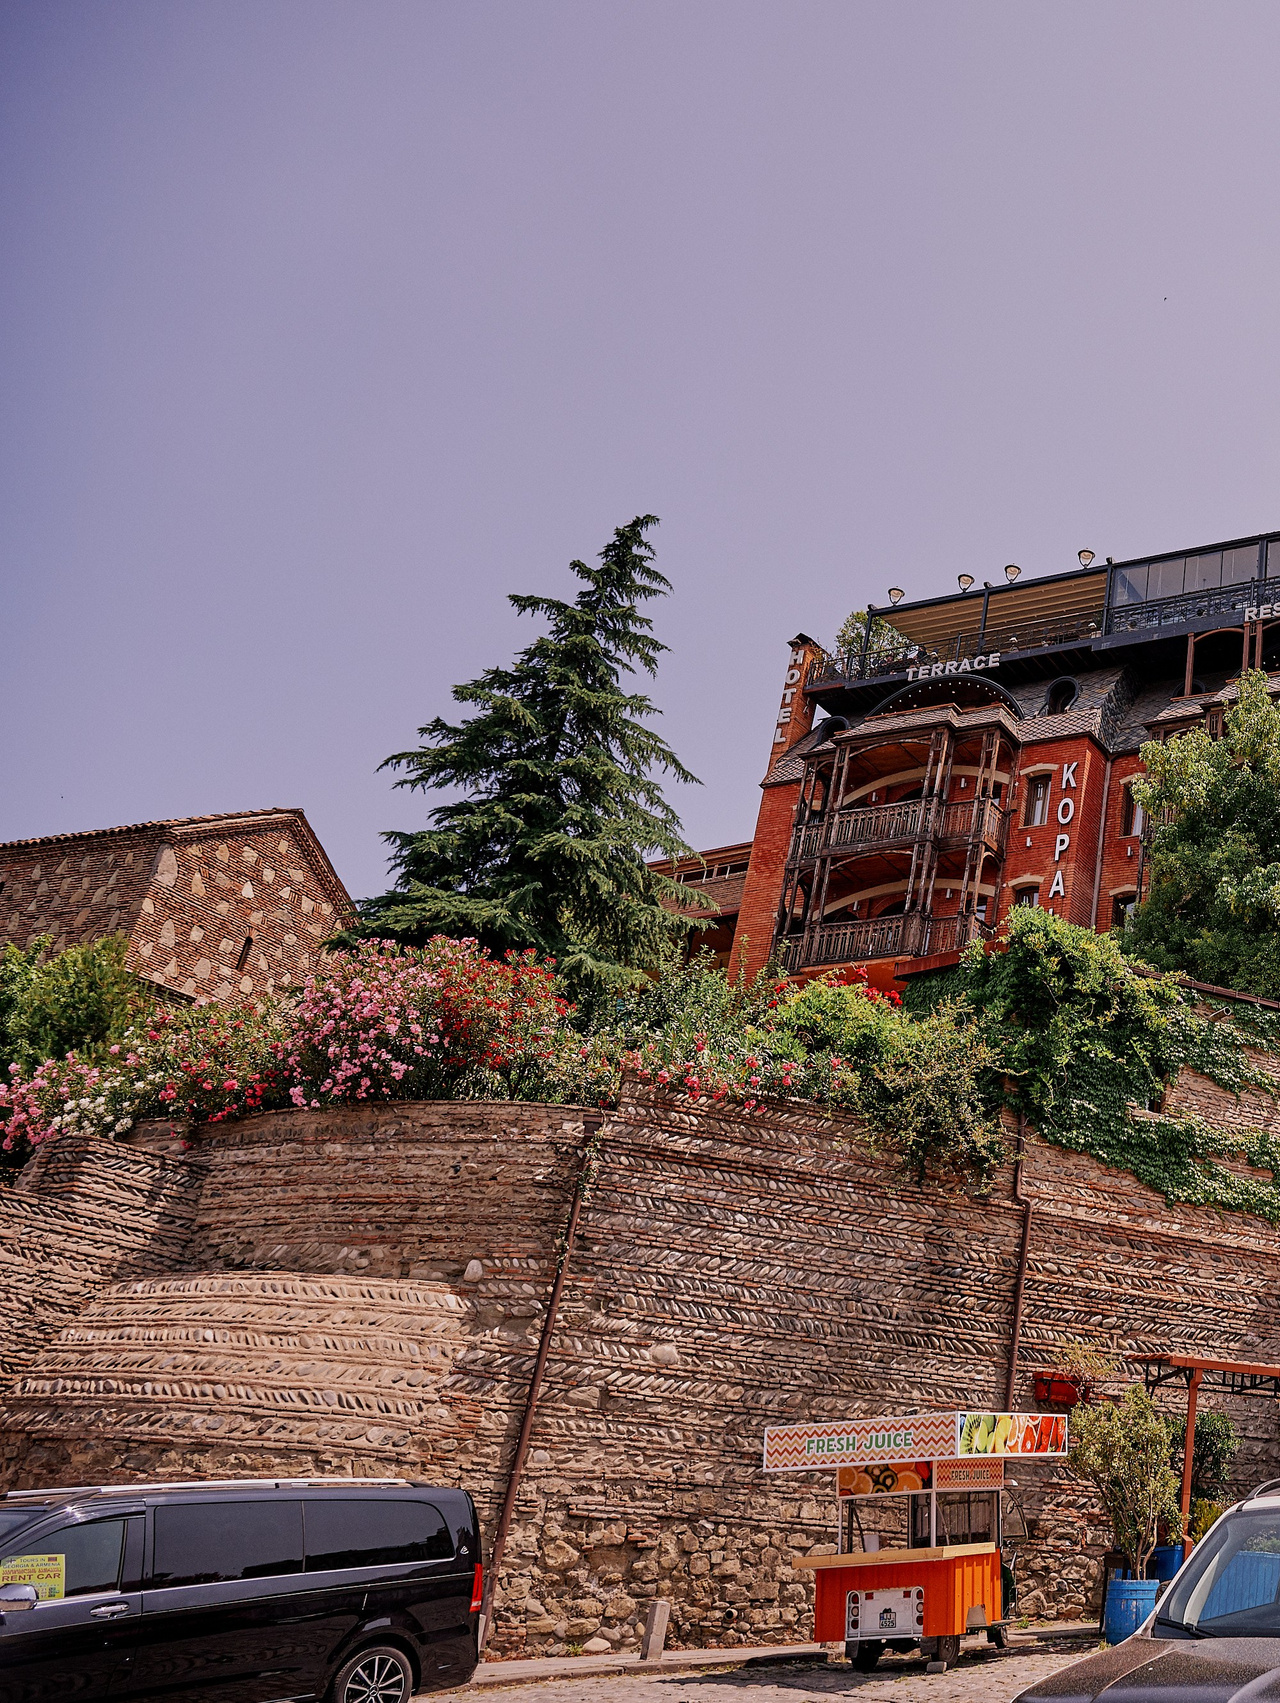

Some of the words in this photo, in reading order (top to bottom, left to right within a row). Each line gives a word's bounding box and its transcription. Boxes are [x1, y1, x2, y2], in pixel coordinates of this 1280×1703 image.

[906, 653, 1001, 681] TERRACE
[774, 649, 803, 743] HOTEL
[1048, 761, 1079, 916] KOPA
[806, 1436, 857, 1454] FRESH
[863, 1431, 913, 1450] JUICE
[951, 1470, 970, 1480] FRESH
[972, 1469, 990, 1479] JUICE
[2, 1574, 33, 1582] RENT
